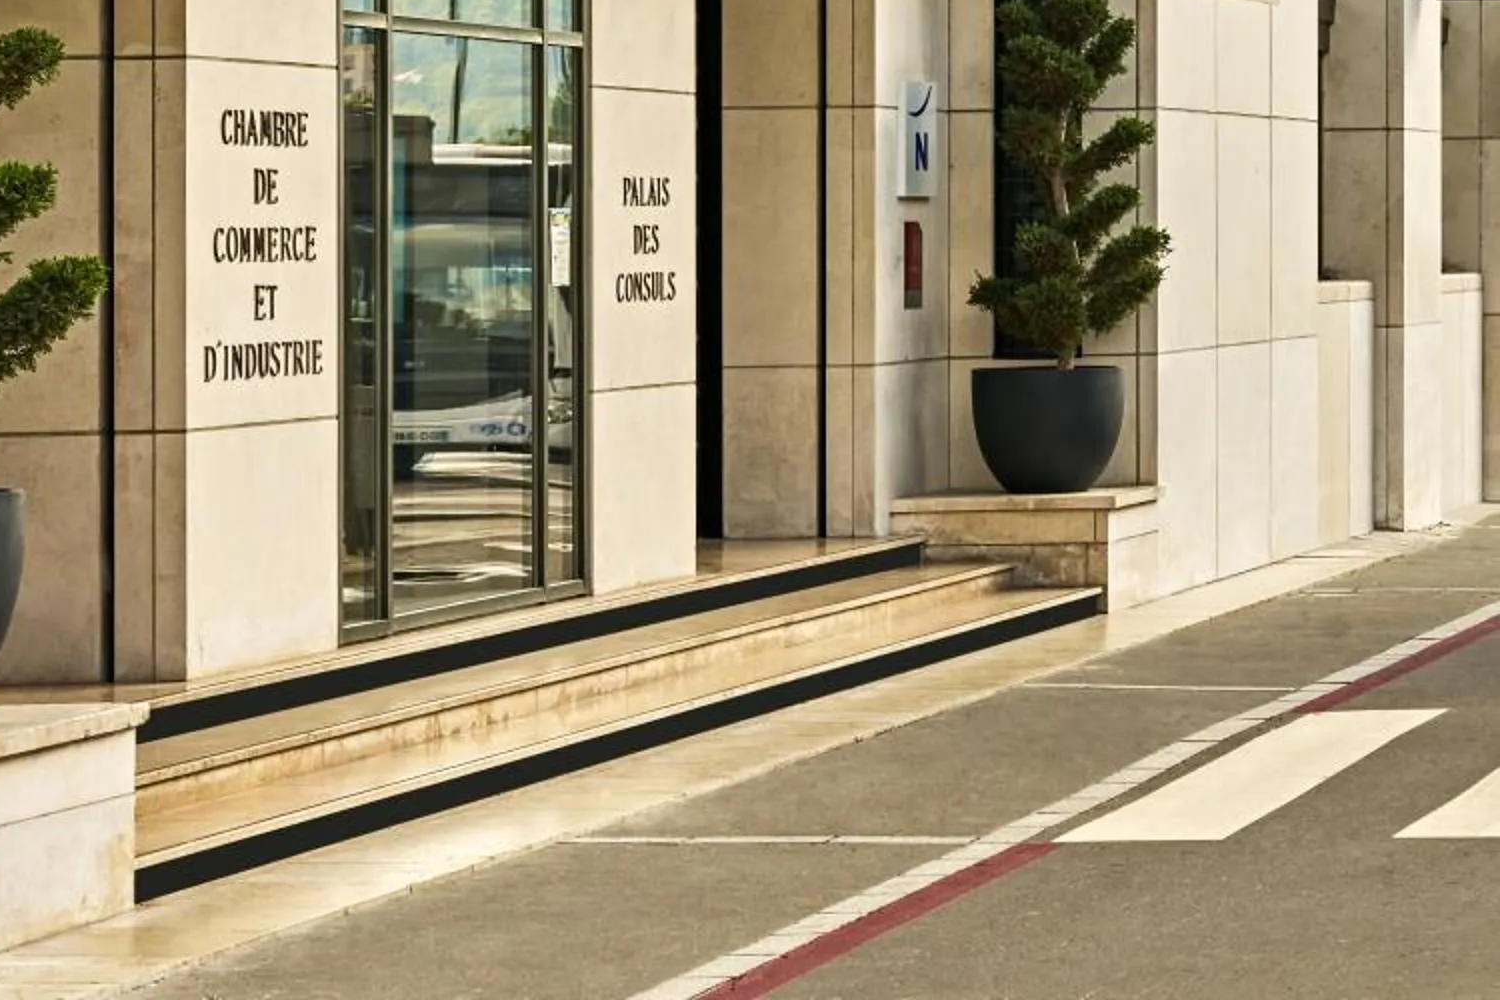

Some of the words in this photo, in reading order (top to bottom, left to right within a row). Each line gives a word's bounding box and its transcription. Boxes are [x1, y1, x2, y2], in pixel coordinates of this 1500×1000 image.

[220, 108, 309, 148] CHAMBRE
[914, 131, 929, 172] N
[252, 167, 279, 205] DE
[622, 176, 671, 207] PALAIS
[212, 225, 318, 264] COMMERCE
[632, 223, 660, 255] DES
[253, 283, 279, 321] ET
[615, 270, 677, 303] CONSULS
[202, 338, 324, 383] D'INDUSTRIE
